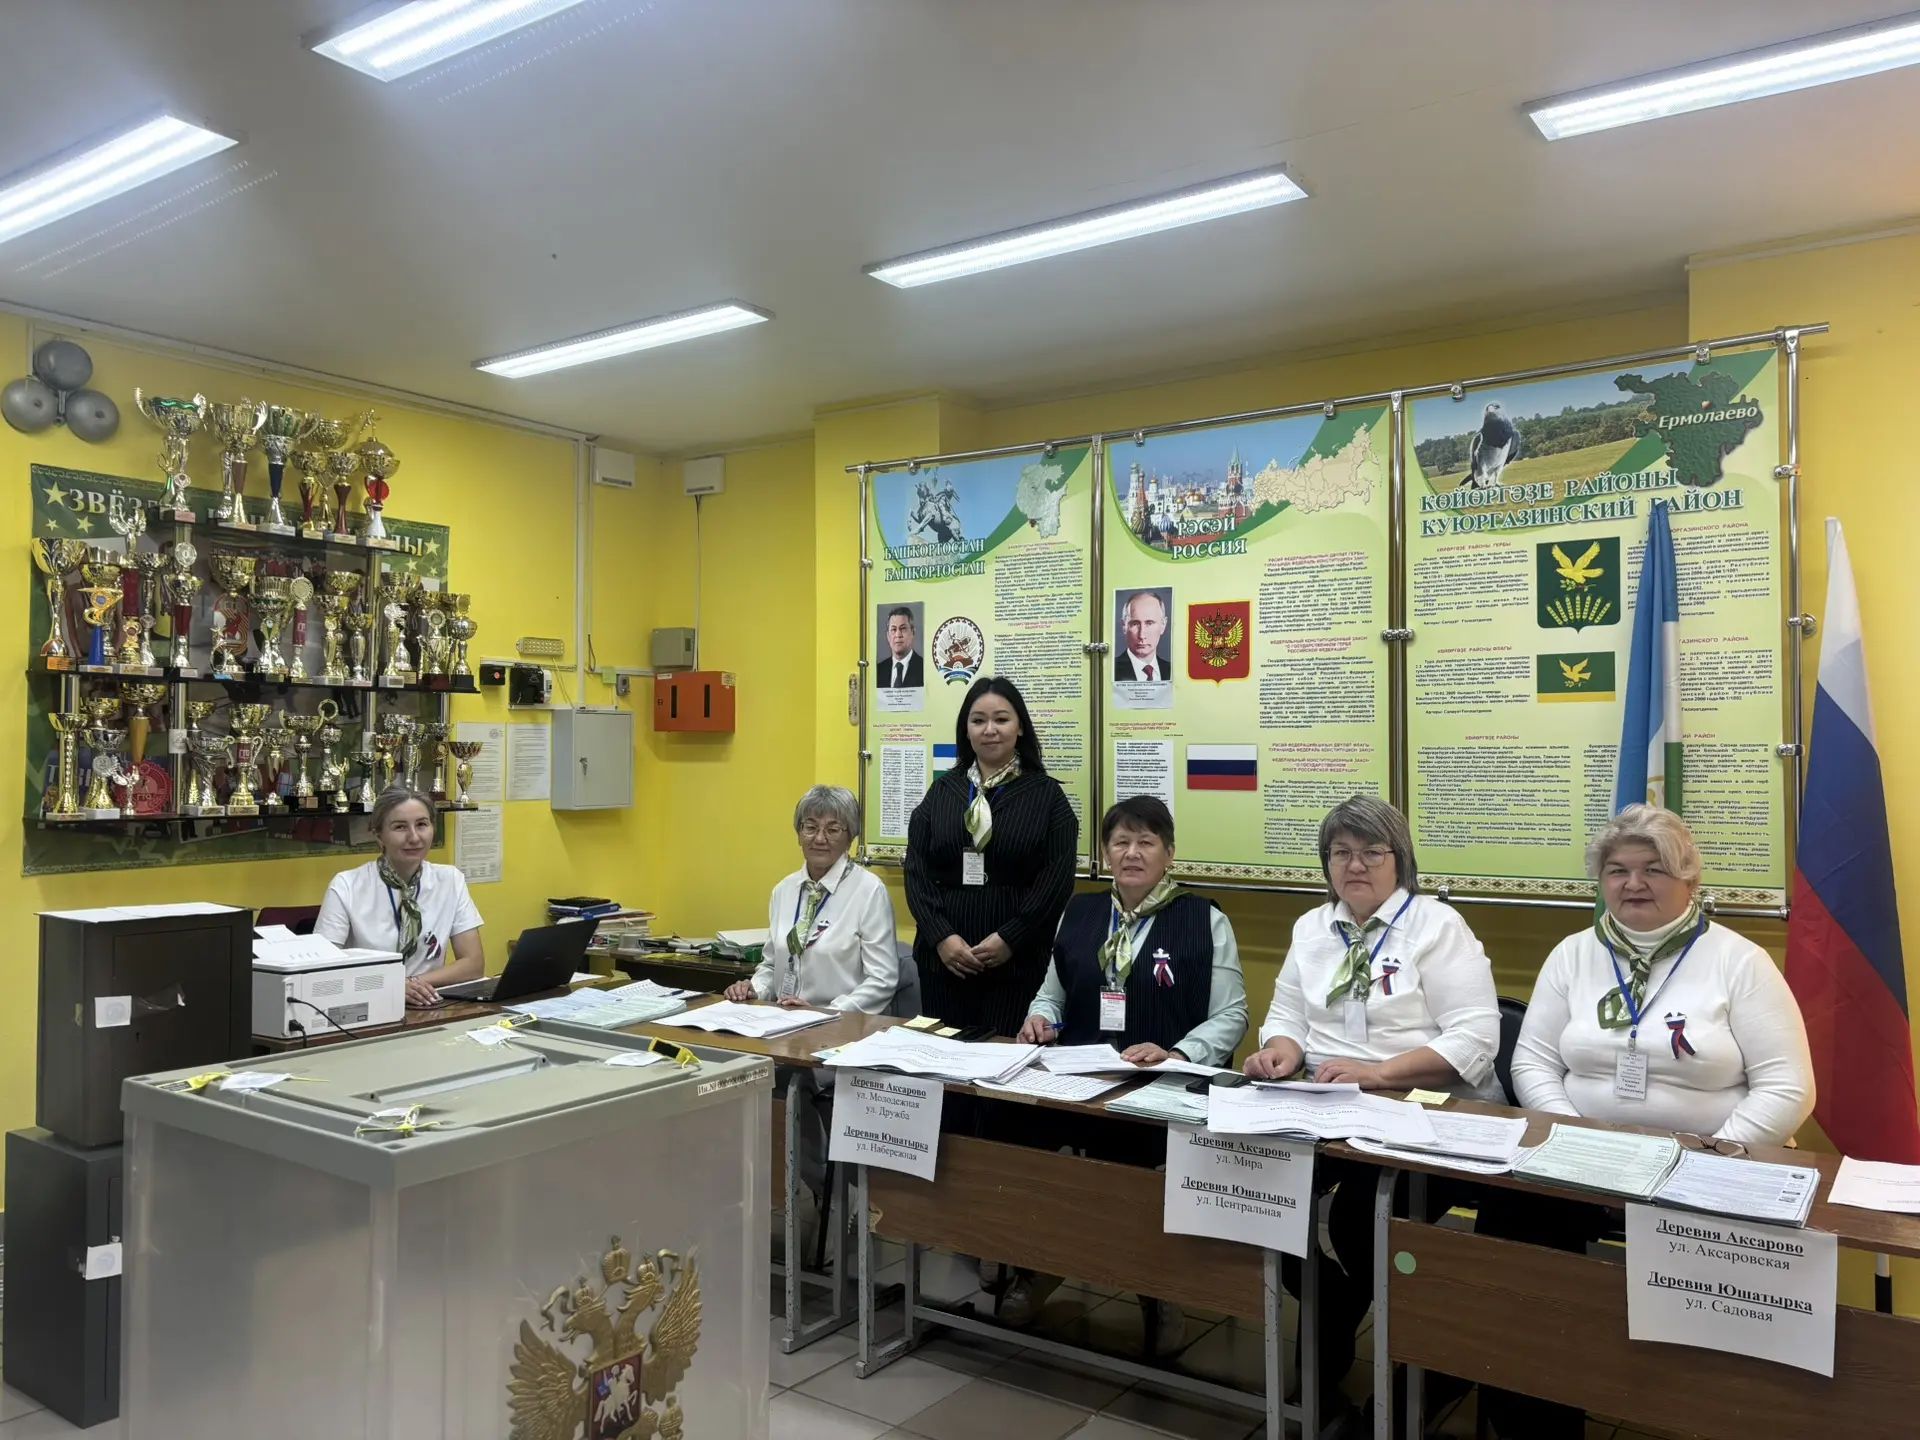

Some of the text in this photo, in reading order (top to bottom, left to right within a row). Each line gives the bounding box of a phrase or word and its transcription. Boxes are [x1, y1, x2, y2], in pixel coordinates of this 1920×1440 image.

[1658, 406, 1758, 430] Ермолаево
[1565, 468, 1678, 498] РАЙОНЫ
[1178, 513, 1235, 536] РӘСӘЙ
[1421, 495, 1637, 537] КУЮРГАЗИНСКИЙ
[1172, 538, 1247, 560] РОССИЯ
[885, 560, 986, 581] БАШКОРТОСТАН
[850, 1076, 927, 1098] Деревня Аксарово
[856, 1091, 920, 1109] ул. Молодежная
[865, 1105, 910, 1120] ул. Дружба
[843, 1126, 929, 1152] Деревня Юшатырка
[1189, 1132, 1292, 1159] Деревня Аксарово
[856, 1142, 918, 1161] ул. Набережная
[1216, 1153, 1263, 1171] ул. Мира
[1181, 1176, 1297, 1207] Деревня Юшатырка
[1196, 1195, 1282, 1218] ул. Центральная
[1656, 1218, 1804, 1255] Деревня Аксарово
[1668, 1241, 1790, 1270] ул. Аксаровская
[1647, 1271, 1813, 1312] Деревня Юшатырка
[1685, 1298, 1773, 1322] ул. Садовая
